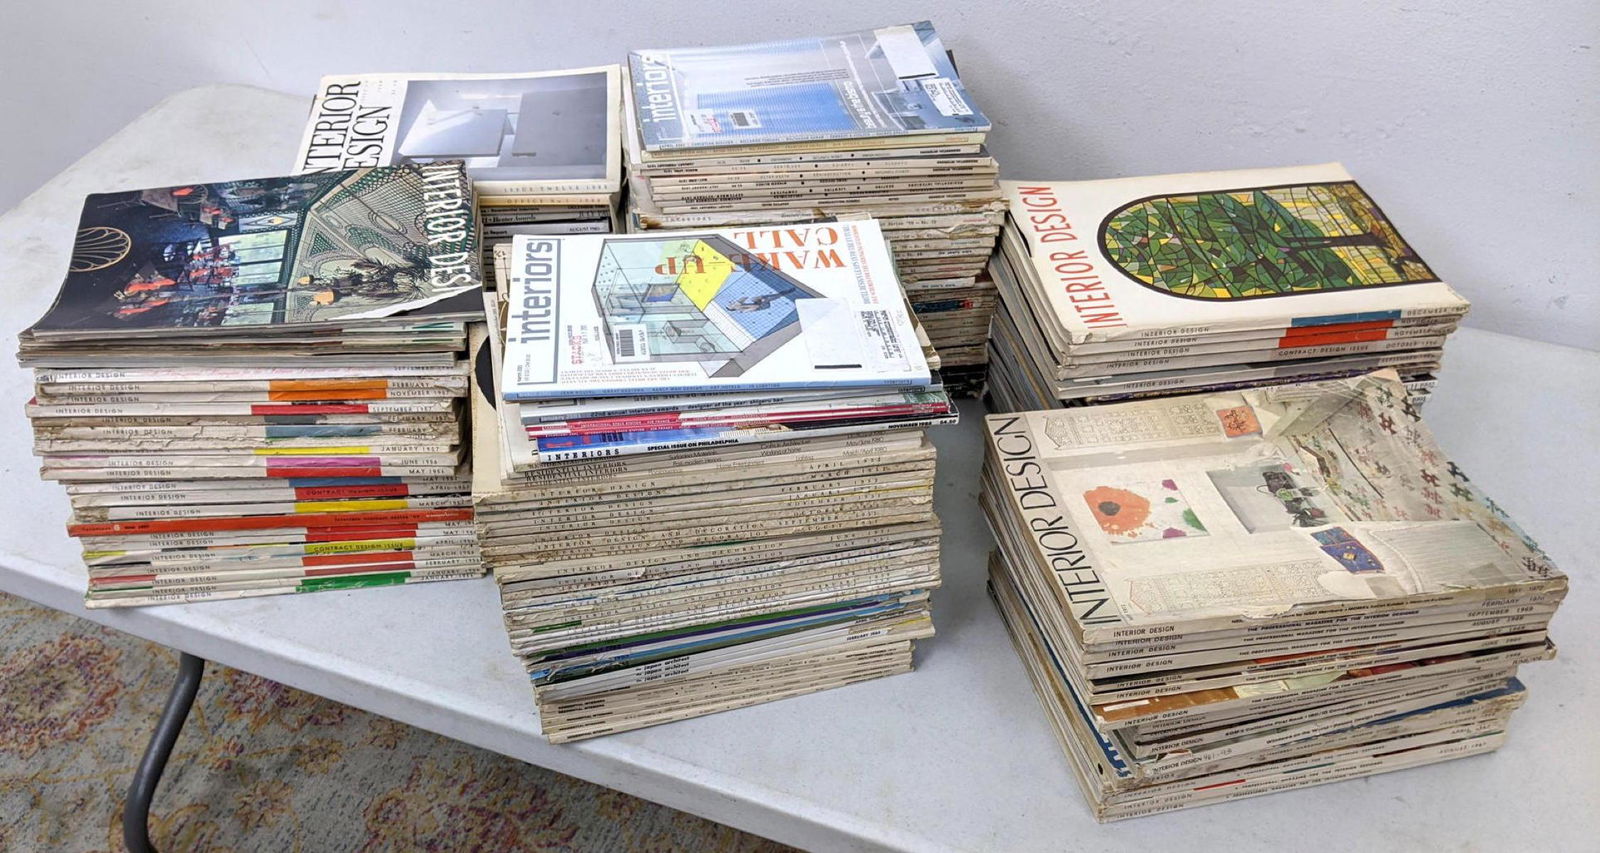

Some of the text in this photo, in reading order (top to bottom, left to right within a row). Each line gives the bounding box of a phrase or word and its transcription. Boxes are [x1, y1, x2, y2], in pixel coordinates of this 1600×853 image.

[304, 80, 361, 173] NTERIOR
[342, 104, 392, 170] ESIGN
[422, 163, 473, 293] INTERIOR DESI
[733, 227, 839, 250] CALL
[655, 248, 847, 276] WAKE UP
[1017, 186, 1129, 329] INTERIOR DESIGN
[508, 241, 553, 344] interiors
[1140, 329, 1177, 338] INTERIOR
[1406, 306, 1447, 316] DECEMBER
[1134, 339, 1168, 347] INTERIOR
[1164, 347, 1190, 355] DESIGN
[1278, 348, 1316, 356] CONTRACT
[1124, 378, 1185, 390] INTERIOR DESIGN
[547, 448, 620, 460] INTERIORS
[698, 438, 739, 446] PHILADELPHIA
[610, 462, 844, 491] DESIGN APRIL
[810, 470, 850, 480] MARCH
[608, 482, 841, 509] DESIGN FEBRUARY
[534, 508, 654, 525] INTERIOR DESIGN
[540, 496, 846, 531] INTERIOR DESIGN NOVEMBER
[1001, 416, 1122, 626] INTERIOR DESIGN
[534, 528, 646, 543] INTERIOR DESIGN
[538, 515, 840, 550] INTERIOR DESIGN AND DECORATION SEPTEMBER
[314, 545, 352, 553] CONTRACT
[557, 564, 614, 574] INTERIOR
[626, 558, 667, 566] DESIGN
[712, 542, 784, 555] DECORATION
[830, 533, 856, 542] JUNE
[558, 574, 614, 585] INTERIOR
[712, 551, 784, 565] DECORATION
[805, 578, 857, 592] FEBRUARY
[564, 572, 856, 622] INTERIOR DESIGN DECORATION JUNE
[1114, 625, 1175, 638] INTERIOR DESIGN
[1116, 637, 1151, 646] INTERIOR
[1153, 634, 1183, 642] DESIGN
[1482, 599, 1520, 607] FEBRUARY
[1108, 648, 1146, 658] INTERIOR
[1148, 644, 1176, 652] DESIGN
[1468, 608, 1510, 617] SEPTEMBER
[644, 656, 690, 670] japan architect
[644, 662, 690, 676] japan architect
[1106, 660, 1173, 672] INTERIOR DESIGN
[644, 668, 690, 683] japan architect
[1116, 674, 1182, 688] INTERIOR DESIGN
[1116, 686, 1182, 699] INTERIOR DESIGN
[1124, 710, 1189, 726] INTERIOR DESIGN
[1152, 738, 1204, 752] INTERIOR DESIGN
[1152, 758, 1202, 774] INTERIOR DESIGN
